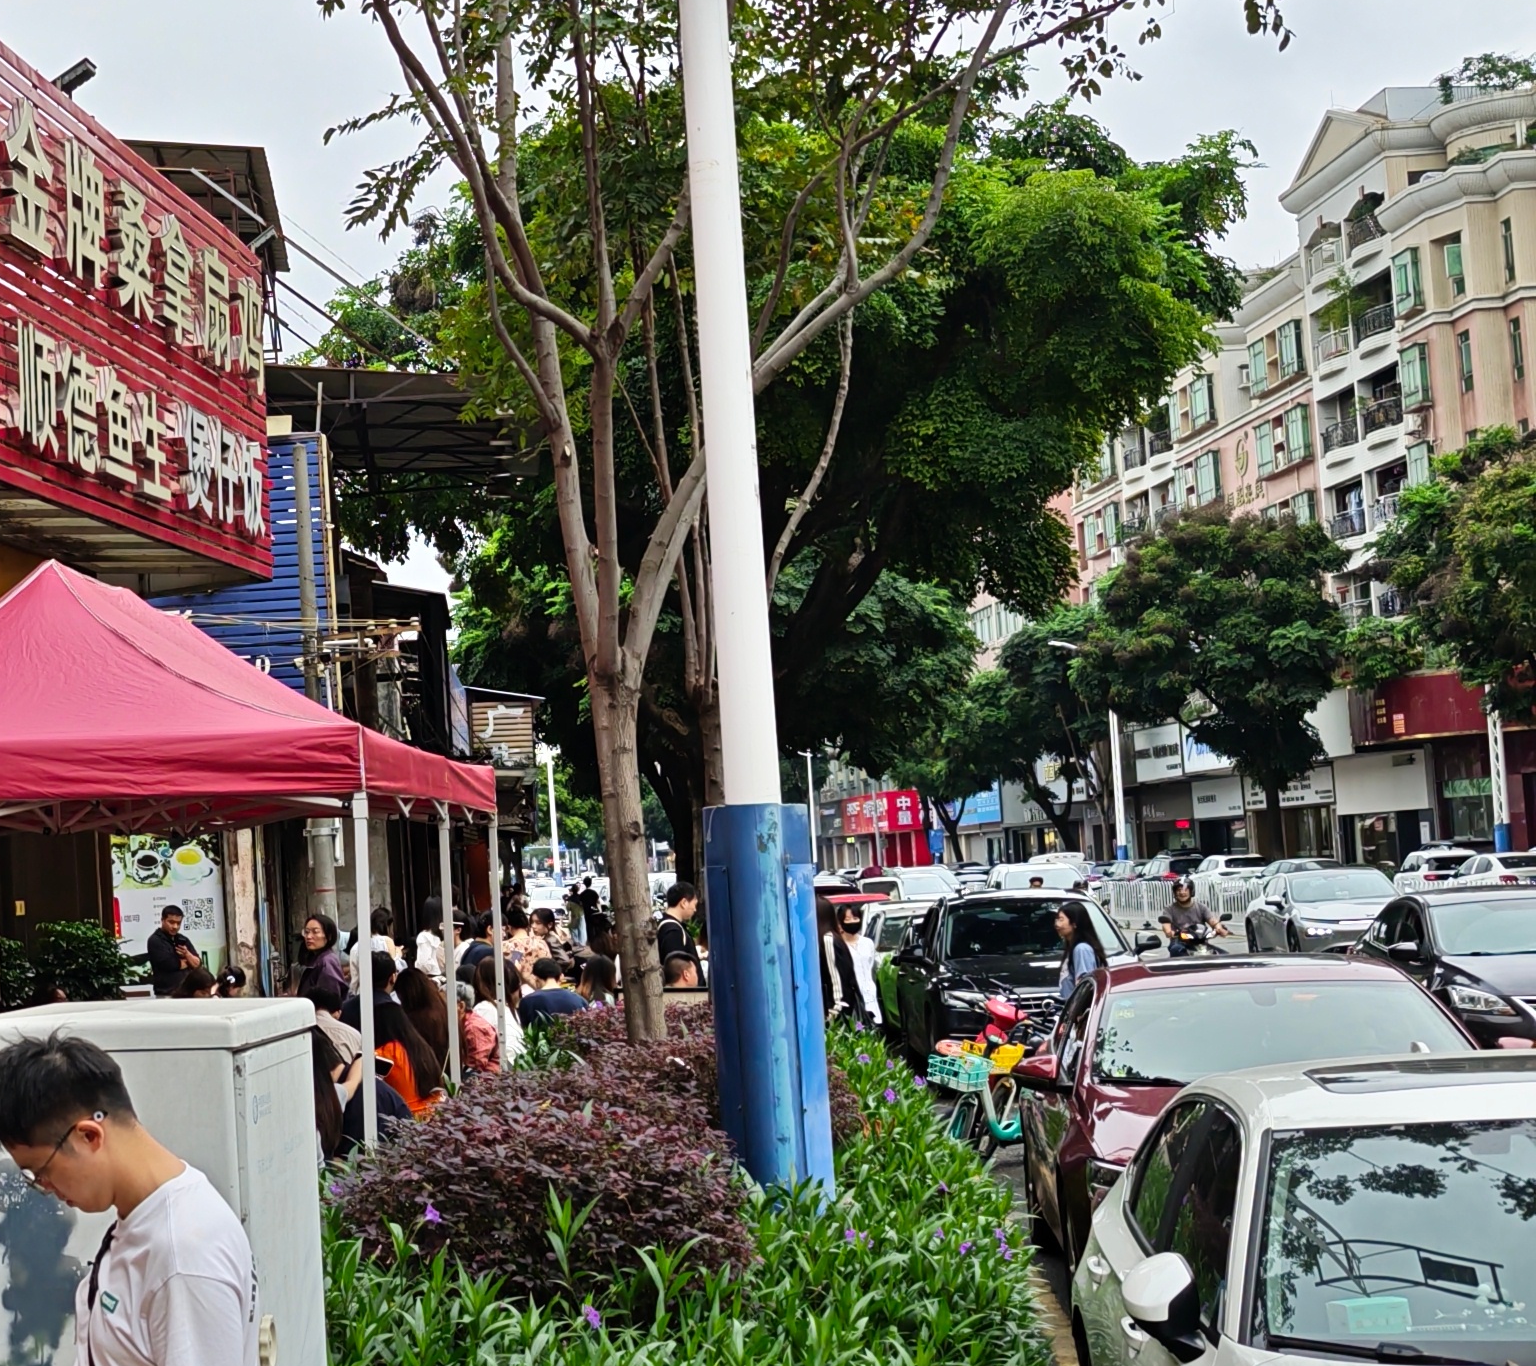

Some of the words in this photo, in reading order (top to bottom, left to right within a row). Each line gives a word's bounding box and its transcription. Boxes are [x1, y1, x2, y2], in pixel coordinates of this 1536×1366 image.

[17, 319, 172, 502] 顺德鱼生
[185, 402, 266, 537] 煲仔饭
